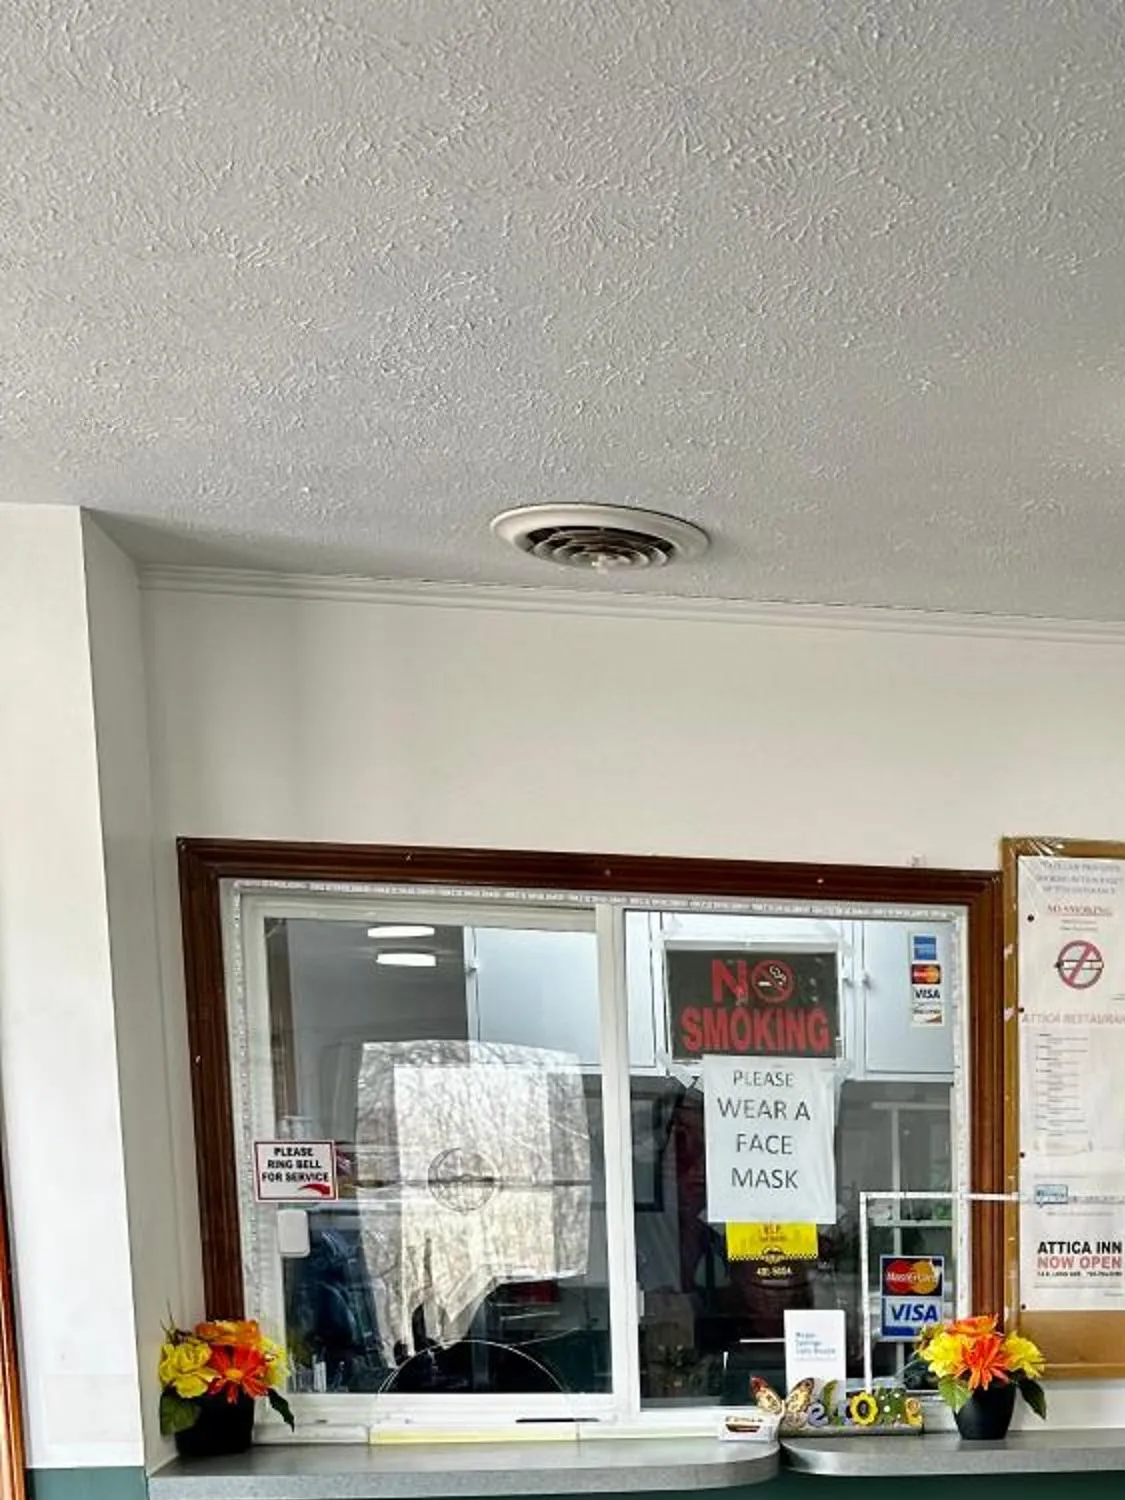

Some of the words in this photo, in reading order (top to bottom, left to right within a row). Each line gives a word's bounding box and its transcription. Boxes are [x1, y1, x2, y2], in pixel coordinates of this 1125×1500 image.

[915, 988, 941, 999] VISA
[681, 1007, 830, 1052] SMOKING
[733, 1069, 794, 1087] PLEASE
[717, 1098, 787, 1120] WEAR
[794, 1101, 811, 1121] A
[274, 1147, 314, 1157] PLEASE
[736, 1134, 793, 1155] FACE
[267, 1160, 293, 1169] RING
[296, 1160, 322, 1169] BELL
[262, 1172, 283, 1182] FOR
[286, 1172, 329, 1182] SERVICE
[731, 1168, 799, 1189] MASK
[1037, 1241, 1092, 1254] ATTICA
[1097, 1241, 1123, 1254] INN
[1036, 1256, 1074, 1269] NOW
[1079, 1256, 1122, 1269] OPEN
[889, 1303, 939, 1322] VISA
